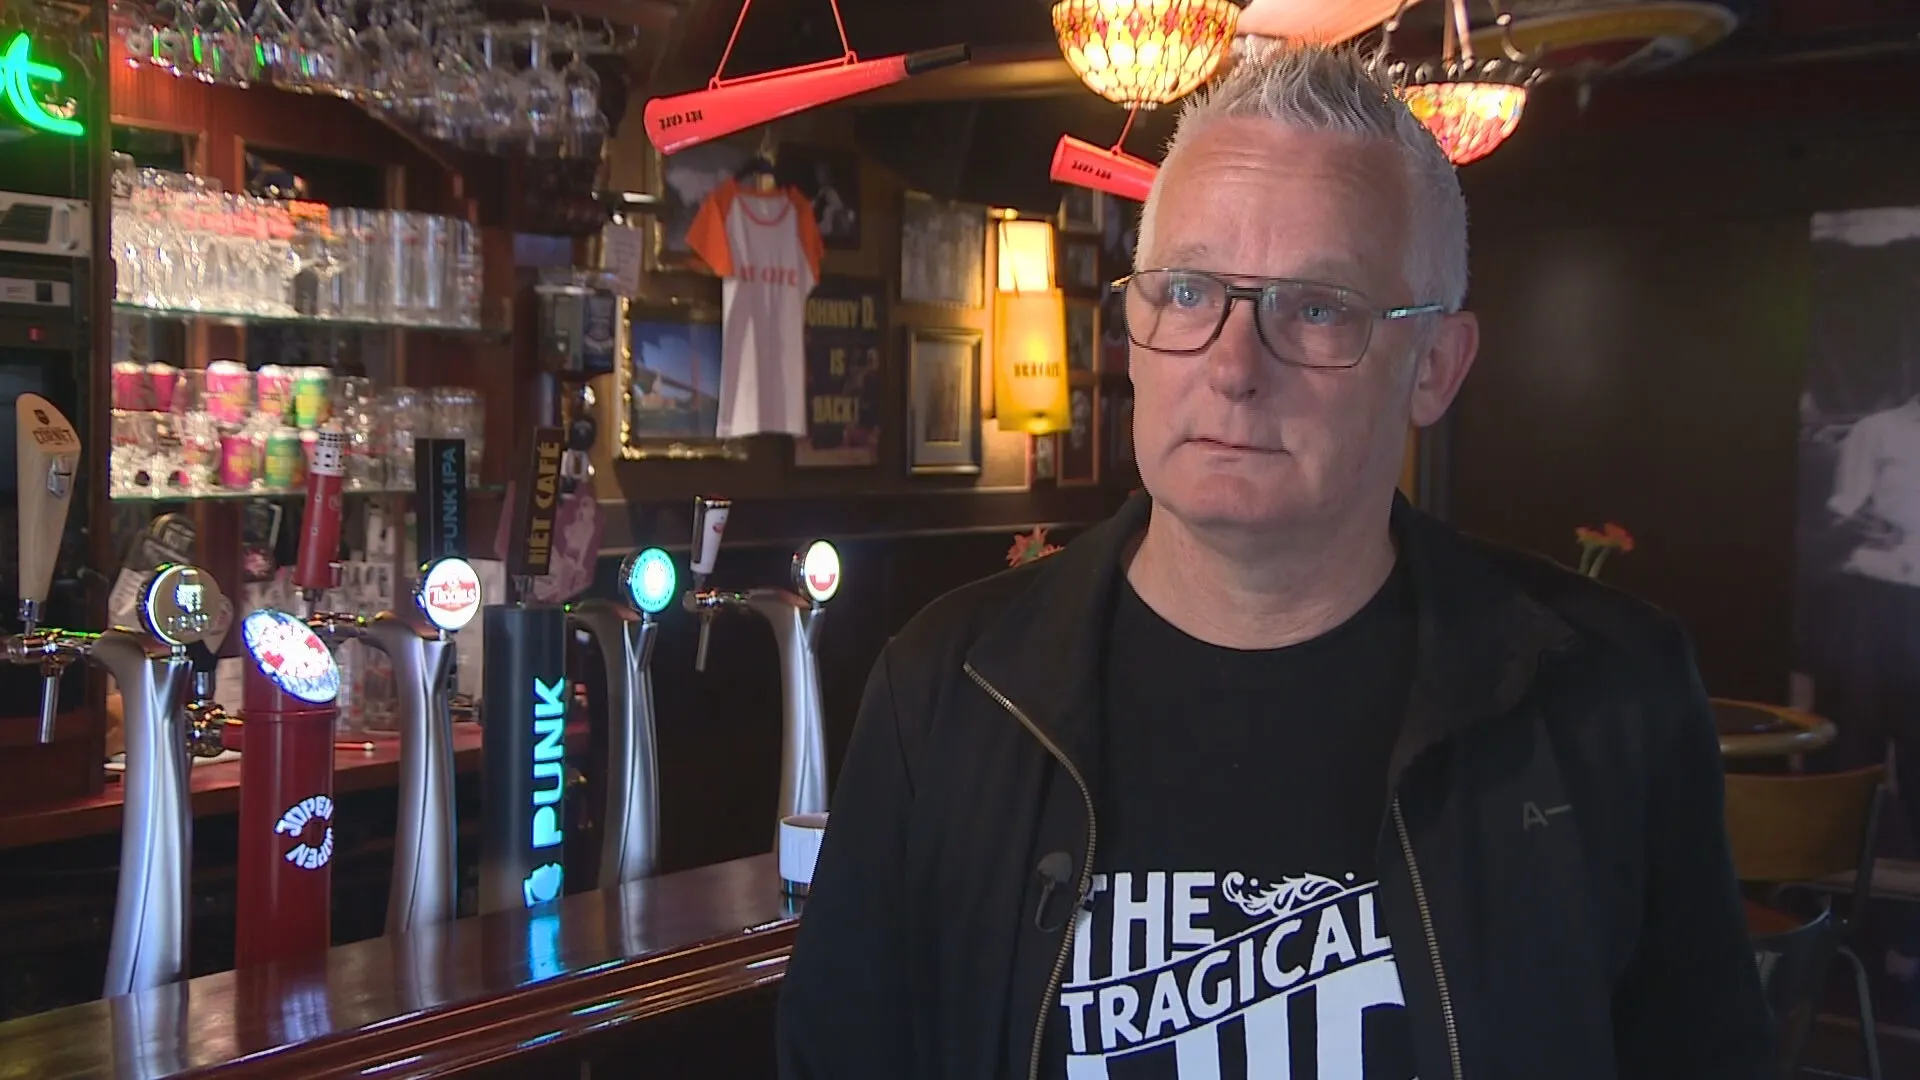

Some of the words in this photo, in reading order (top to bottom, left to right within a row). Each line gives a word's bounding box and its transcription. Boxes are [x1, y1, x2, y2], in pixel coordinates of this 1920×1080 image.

[806, 298, 858, 327] OHNNY
[830, 348, 845, 375] IS
[442, 447, 456, 484] IPA
[533, 677, 565, 848] PUNK
[275, 795, 333, 837] JOPEN
[1073, 871, 1215, 985] THE
[1060, 893, 1392, 1053] TRAGICAL
